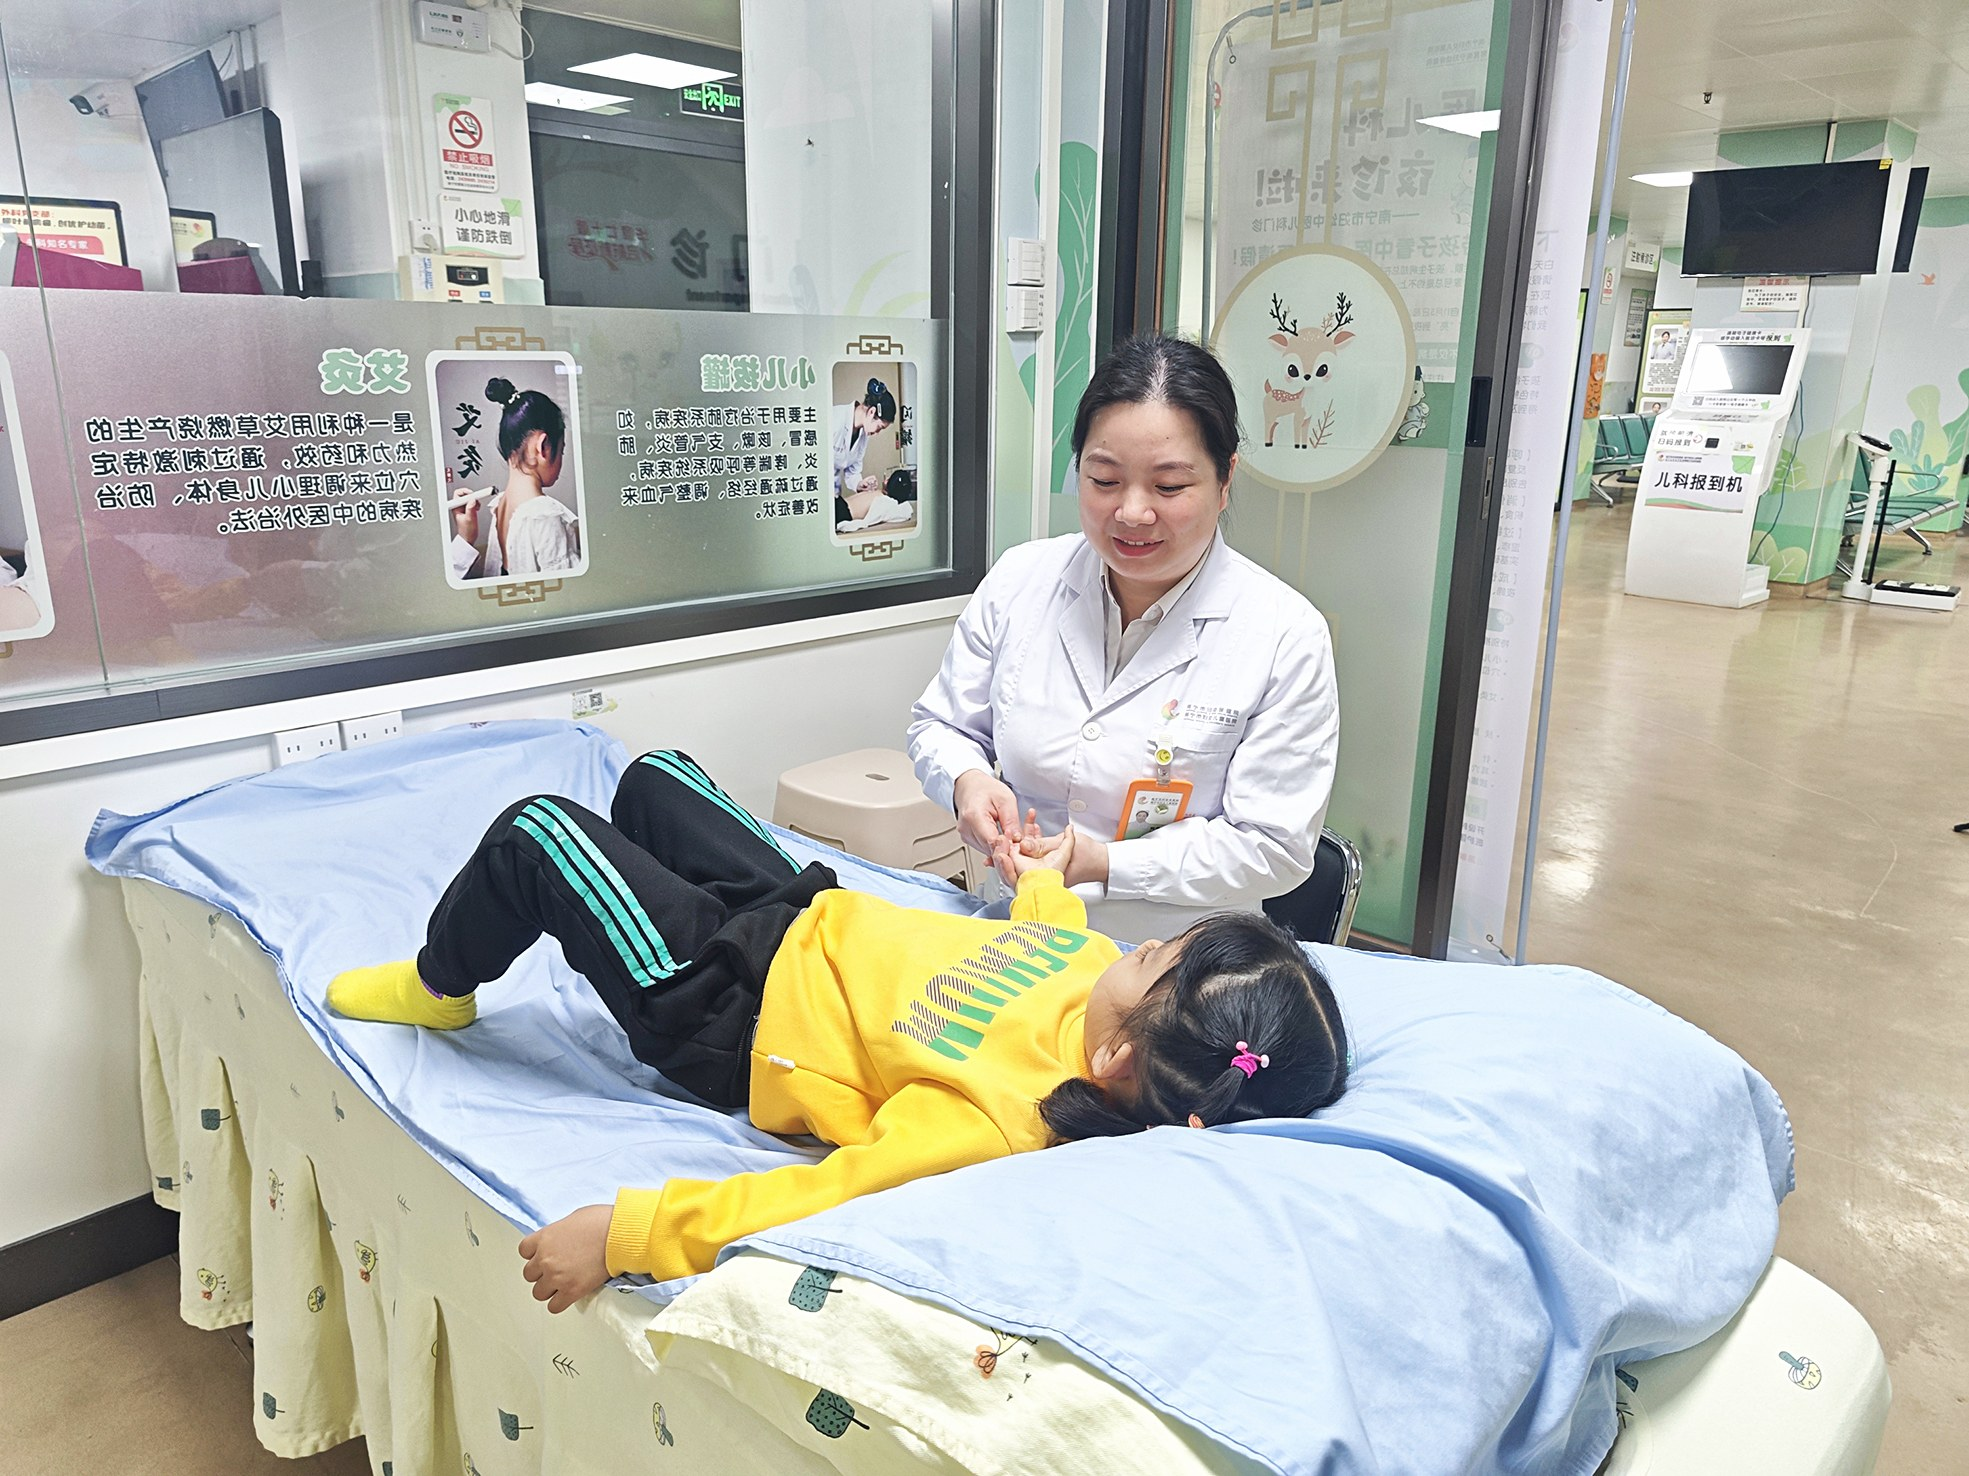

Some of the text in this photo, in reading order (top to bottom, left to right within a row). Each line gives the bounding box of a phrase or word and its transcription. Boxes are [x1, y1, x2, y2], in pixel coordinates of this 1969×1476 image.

[724, 94, 741, 108] EXIT
[446, 150, 491, 165] 禁止吸烟
[454, 207, 511, 226] 小心地滑
[456, 227, 513, 245] 谨防跌倒
[1654, 471, 1743, 492] 儿科报到机
